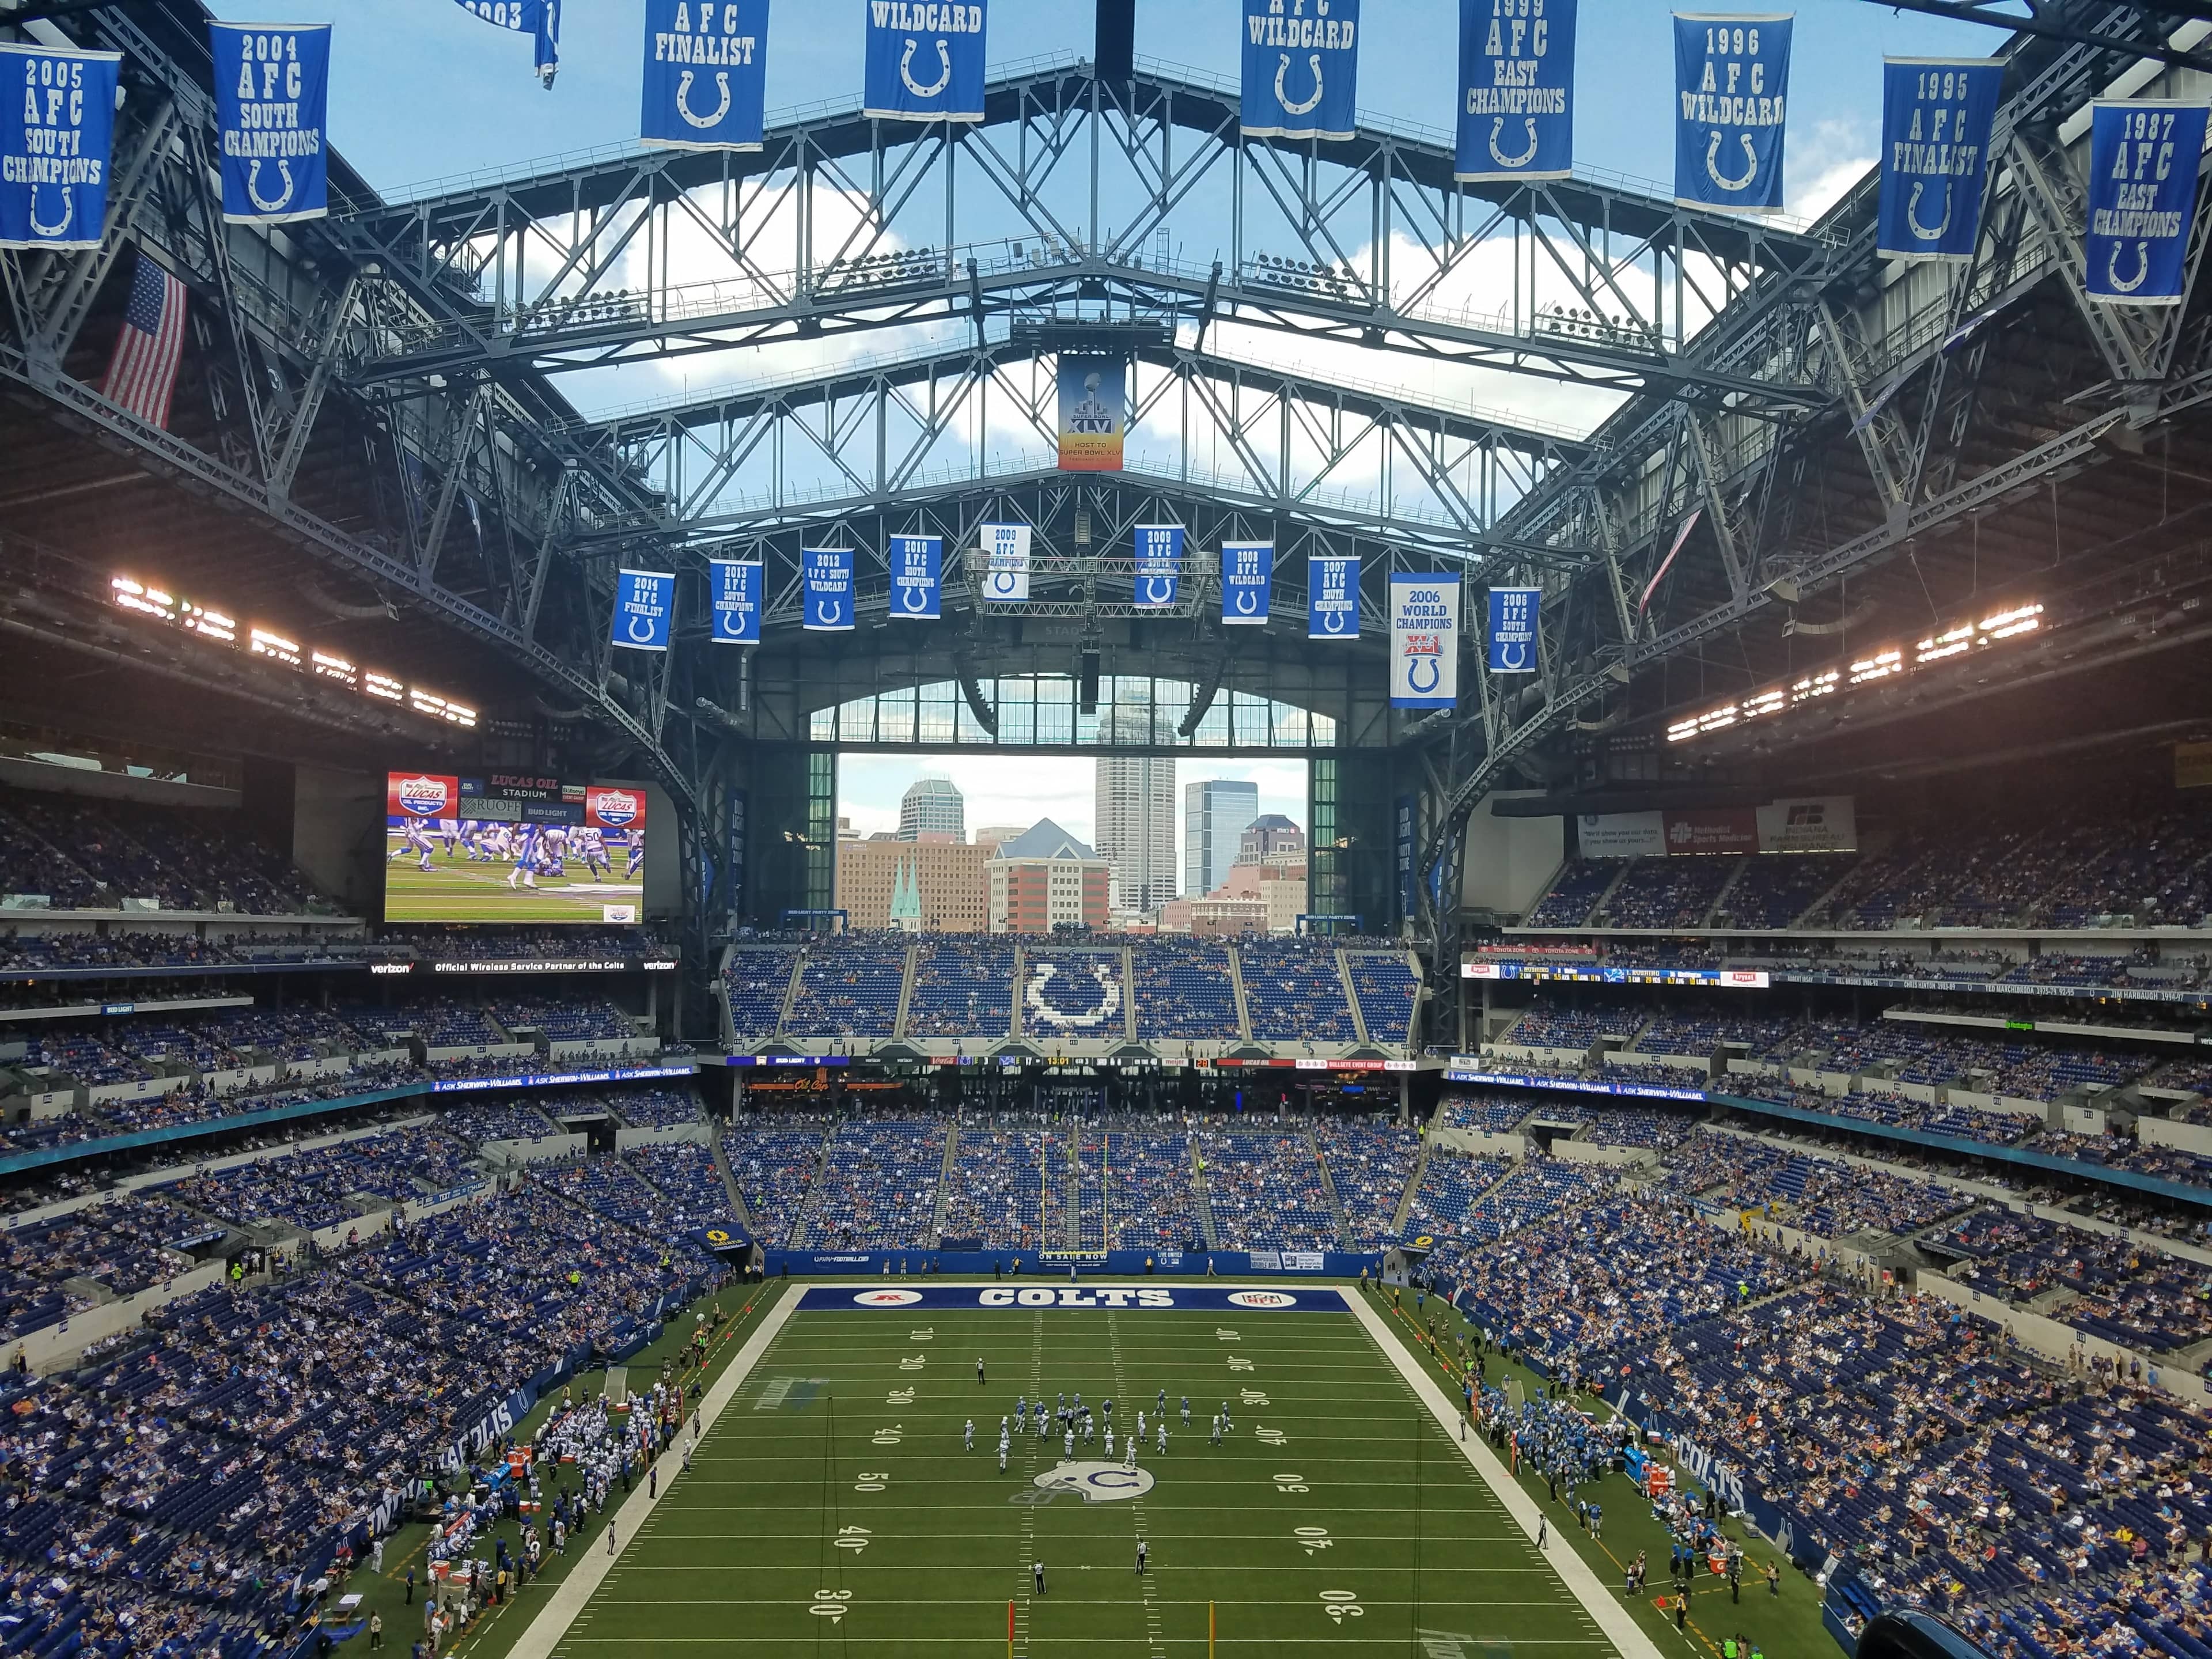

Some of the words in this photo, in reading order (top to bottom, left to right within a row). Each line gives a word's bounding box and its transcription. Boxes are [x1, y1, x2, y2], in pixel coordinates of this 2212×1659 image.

[675, 1, 737, 35] AFC
[871, 1, 982, 33] WILDCARD
[1248, 16, 1354, 50] WILDCARD
[1485, 19, 1547, 57] AFC
[242, 34, 297, 62] 2004
[1707, 28, 1759, 55] 1996
[655, 33, 755, 66] FINALIST
[26, 59, 83, 88] 2005
[1494, 60, 1538, 86] EAST
[1702, 61, 1764, 94] AFC
[237, 62, 301, 100] AFC
[1918, 72, 1967, 101] 1995
[24, 88, 83, 126] AFC
[1467, 88, 1565, 114] CHAMPIONS
[1681, 90, 1783, 126] WILDCARD
[240, 102, 298, 128] SOUTH
[1910, 108, 1966, 142] AFC
[2124, 113, 2175, 139] 1987
[25, 128, 81, 156] SOUTH
[224, 127, 319, 157] CHAMPIONS
[1893, 142, 1978, 176] FINALIST
[2112, 142, 2175, 180] AFC
[2, 155, 102, 185] CHAMPIONS
[2117, 183, 2158, 210] EAST
[2093, 209, 2181, 237] CHAMPIONS
[995, 529, 1017, 540] 2009
[1147, 531, 1171, 543] 2009
[904, 540, 927, 554] 2010
[996, 543, 1014, 555] AFC
[817, 555, 840, 567] 2012
[904, 554, 927, 566] AFC
[725, 566, 747, 578] 2013
[1237, 563, 1257, 575] AFC
[1324, 562, 1346, 573] 2007
[634, 577, 658, 591] 2014
[724, 578, 746, 590] AFC
[810, 580, 847, 592] WILDCARD
[897, 577, 934, 588] CHAMPIONS
[1229, 575, 1265, 585] WILDCARD
[1323, 573, 1346, 588] AFC
[633, 590, 657, 604] AFC
[1323, 589, 1344, 600] SOUTH
[1410, 590, 1440, 603] 2006
[1503, 594, 1527, 607] 2006
[624, 602, 664, 617] FINALIST
[715, 601, 753, 612] CHAMPIONS
[1402, 605, 1446, 616] WORLD
[1503, 608, 1527, 620] AFC
[1396, 618, 1452, 629] CHAMPIONS
[1503, 621, 1525, 631] SOUTH
[1495, 631, 1532, 642] CHAMPIONS
[491, 775, 533, 787] LUCAS
[536, 778, 558, 789] OIL
[406, 789, 443, 798] LUCAS
[502, 789, 547, 798] STADIUM
[478, 798, 521, 813] RUOFF
[602, 801, 632, 810] LUCAS
[585, 832, 600, 842] 50
[1785, 826, 1828, 834] INDIANA
[1693, 834, 1717, 844] Sports
[371, 964, 410, 974] verizon
[435, 963, 467, 972] Official
[470, 963, 508, 971] Wireless
[511, 962, 542, 971] Service
[545, 961, 576, 970] Partner
[578, 961, 587, 969] of
[643, 960, 675, 970] verizon
[1904, 980, 1918, 988] CHRIS
[1919, 981, 1936, 990] HINTON
[2111, 989, 2123, 998] JIM
[2123, 990, 2158, 1000] HARBAUGH
[2161, 991, 2184, 1001] 1994-97
[107, 1006, 118, 1014] BUD
[118, 1005, 132, 1013] LIGHT
[442, 1082, 457, 1090] ASK
[794, 1078, 809, 1090] Oil
[811, 1080, 829, 1090] Can
[979, 1288, 1174, 1306] COLTS
[1247, 1297, 1279, 1305] NFL
[910, 1328, 934, 1340] 10
[1216, 1328, 1241, 1341] 10
[898, 1357, 926, 1370] 20
[1227, 1358, 1255, 1371] 20
[886, 1389, 915, 1404] 30
[1240, 1391, 1270, 1405] 30
[872, 1427, 903, 1444] 40
[1255, 1429, 1288, 1446] 40
[367, 1400, 513, 1535] INDIAAPOLIS
[1677, 1434, 1745, 1513] COLTS
[854, 1472, 889, 1492] 50
[1272, 1474, 1309, 1493] 50
[834, 1525, 872, 1548] 40
[1294, 1527, 1333, 1549] 40
[809, 1589, 853, 1616] 30
[1319, 1590, 1363, 1617] 30
